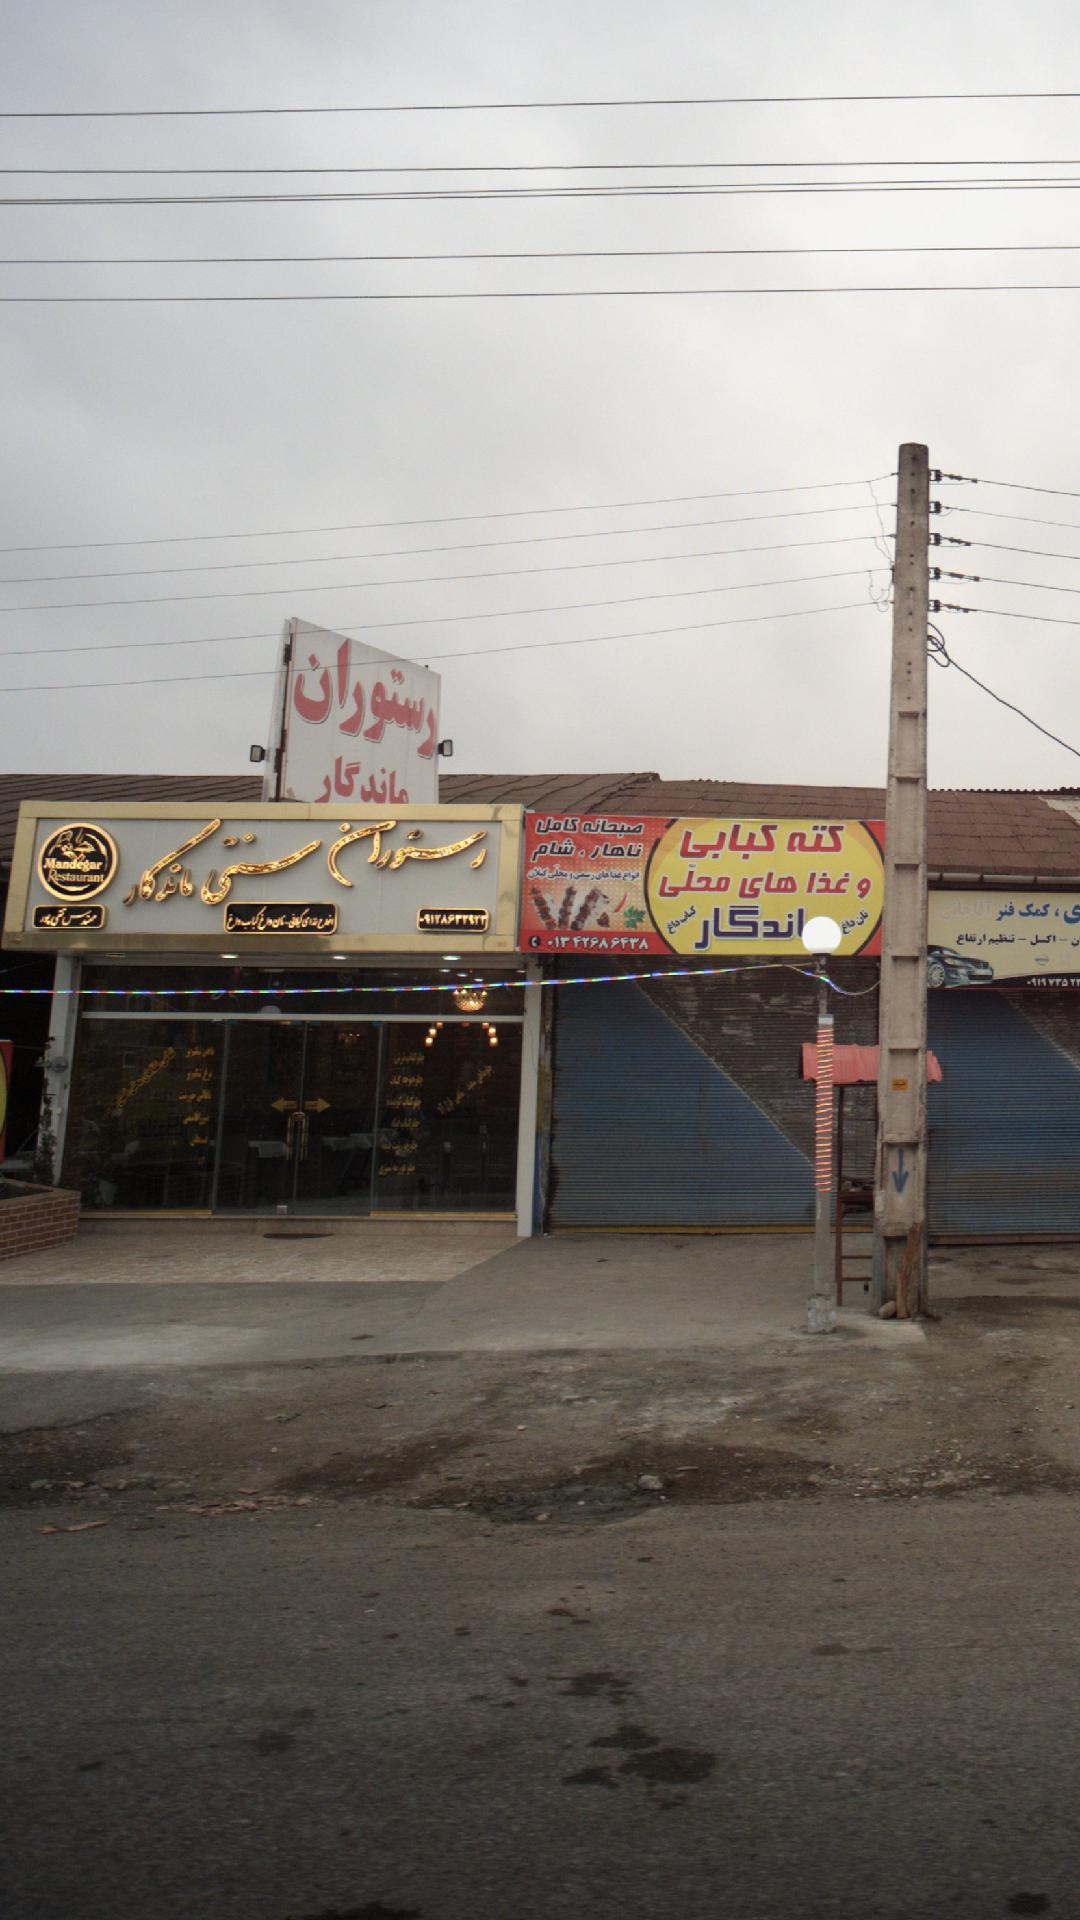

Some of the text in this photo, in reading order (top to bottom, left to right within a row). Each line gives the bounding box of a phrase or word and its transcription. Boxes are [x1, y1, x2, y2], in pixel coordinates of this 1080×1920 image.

[293, 638, 437, 760] رستوران
[314, 755, 410, 804] ماندگار
[535, 816, 645, 838] صبحانه کامل
[530, 838, 643, 863] ناهار شام
[679, 823, 844, 861] کته کبابی
[43, 857, 104, 872] Mandegar
[122, 818, 221, 906] ماندگار
[327, 819, 488, 888] رستوران
[48, 869, 105, 883] Restaurant
[738, 871, 798, 899] های
[806, 871, 850, 894] غذا
[857, 877, 872, 899] و
[996, 900, 1015, 921] فنر
[1018, 902, 1050, 917] کمک
[694, 905, 806, 950] اندگار
[956, 933, 987, 946] ارتفاع
[988, 933, 1015, 945] تنظیم
[1030, 934, 1056, 946] اکسل
